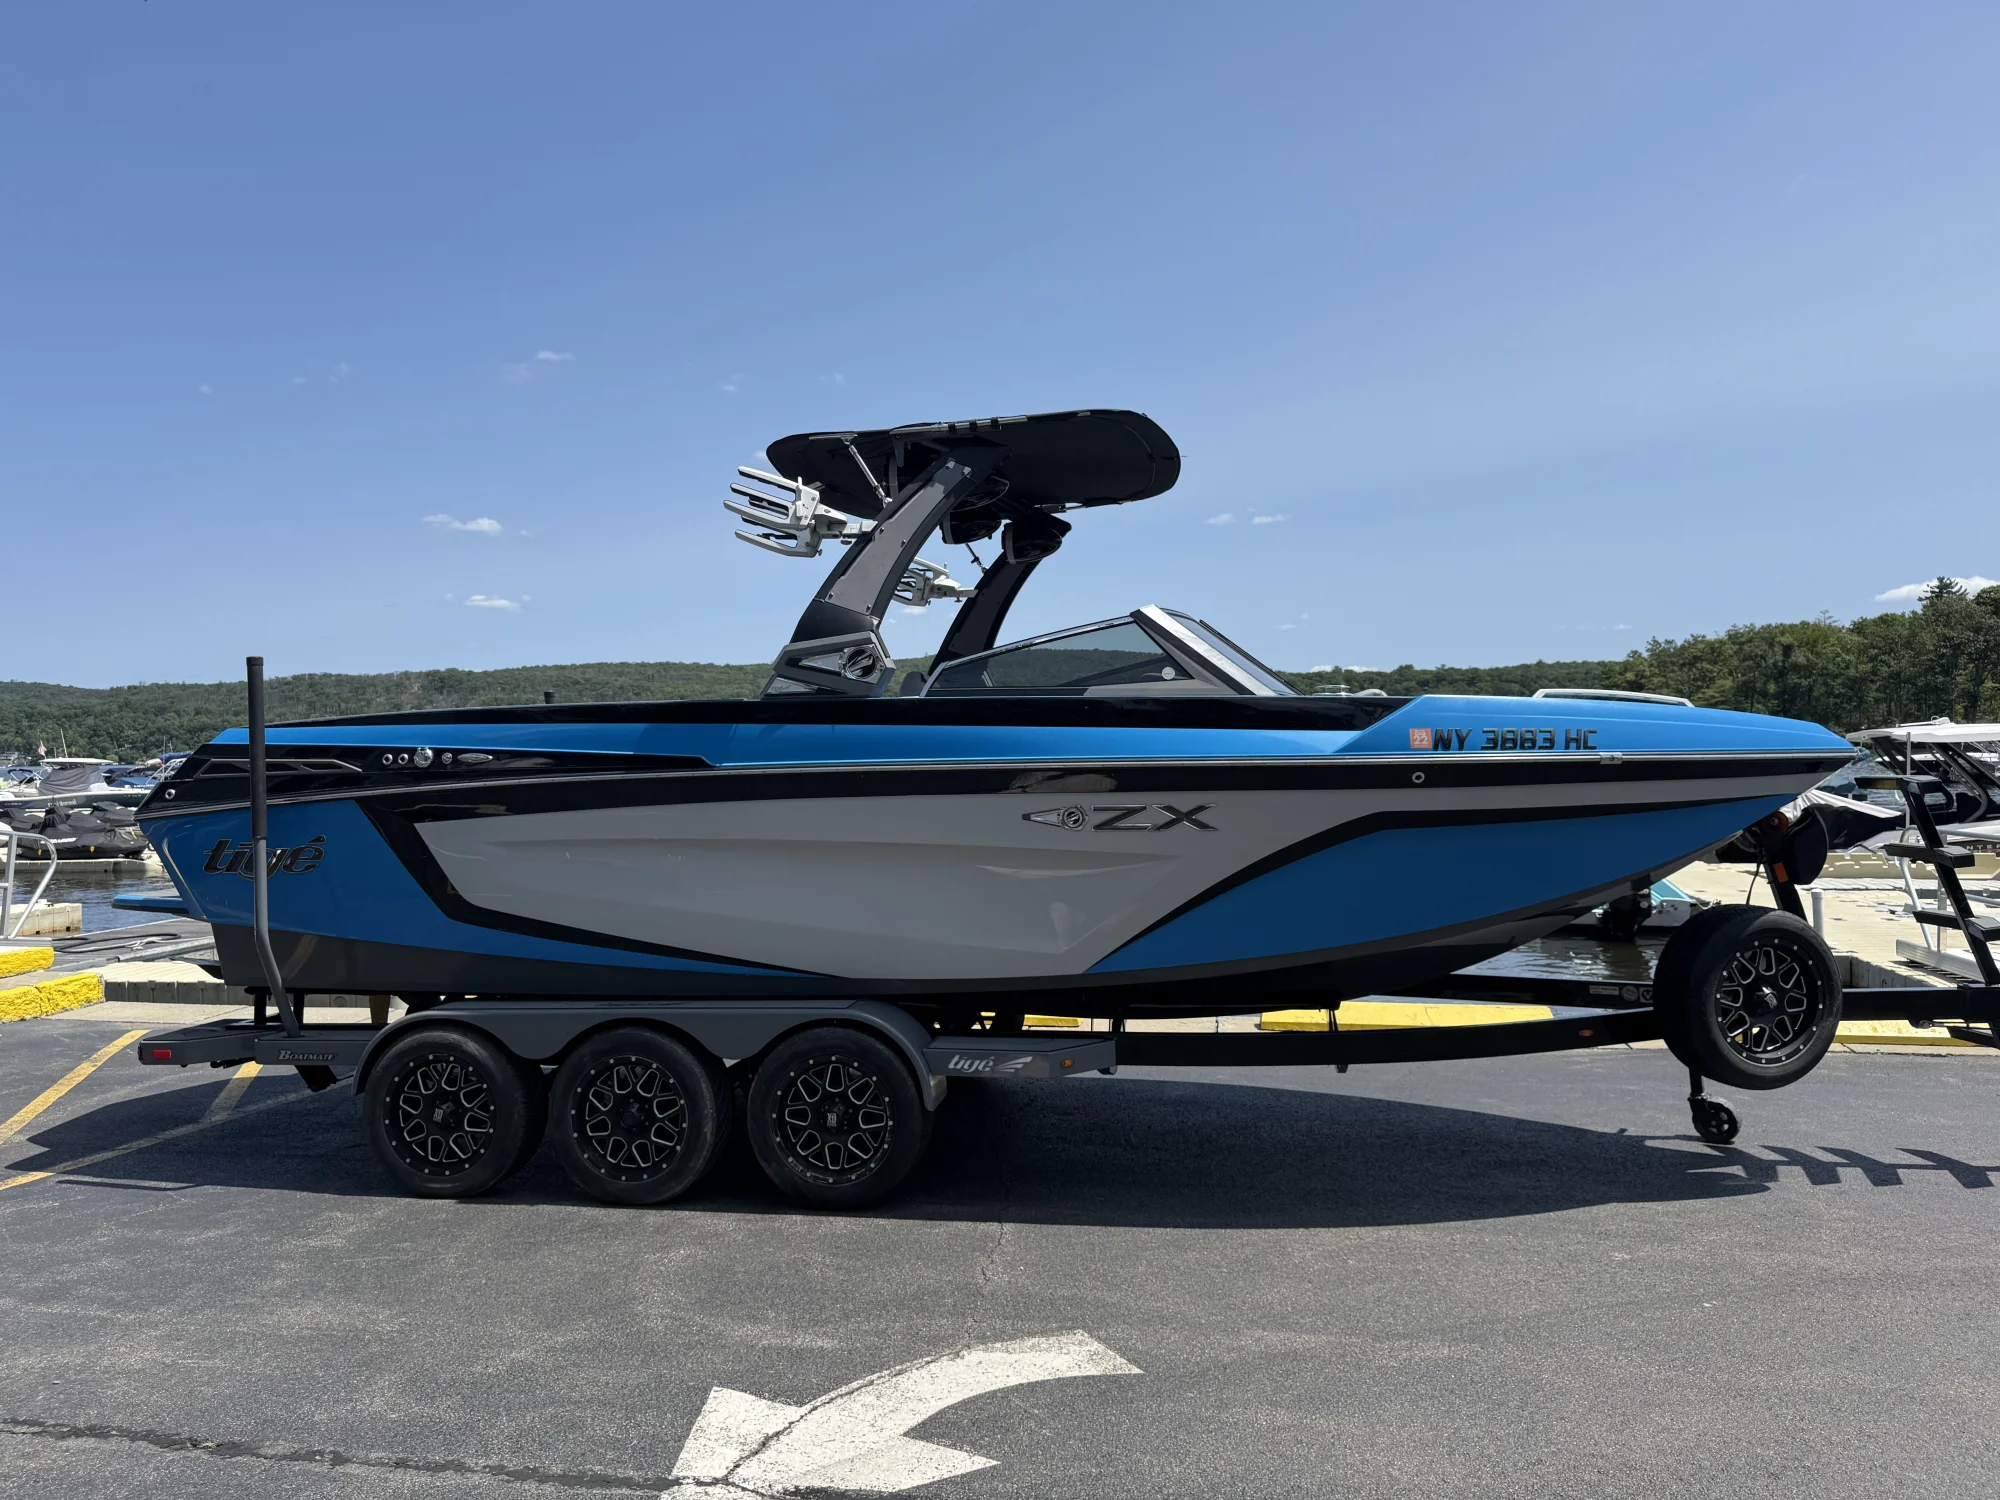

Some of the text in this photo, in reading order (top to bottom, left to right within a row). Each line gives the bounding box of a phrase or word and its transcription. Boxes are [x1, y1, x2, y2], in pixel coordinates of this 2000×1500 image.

[1413, 735, 1429, 744] 22
[1433, 728, 1598, 751] NY 3883 HC
[1091, 803, 1219, 831] ZX
